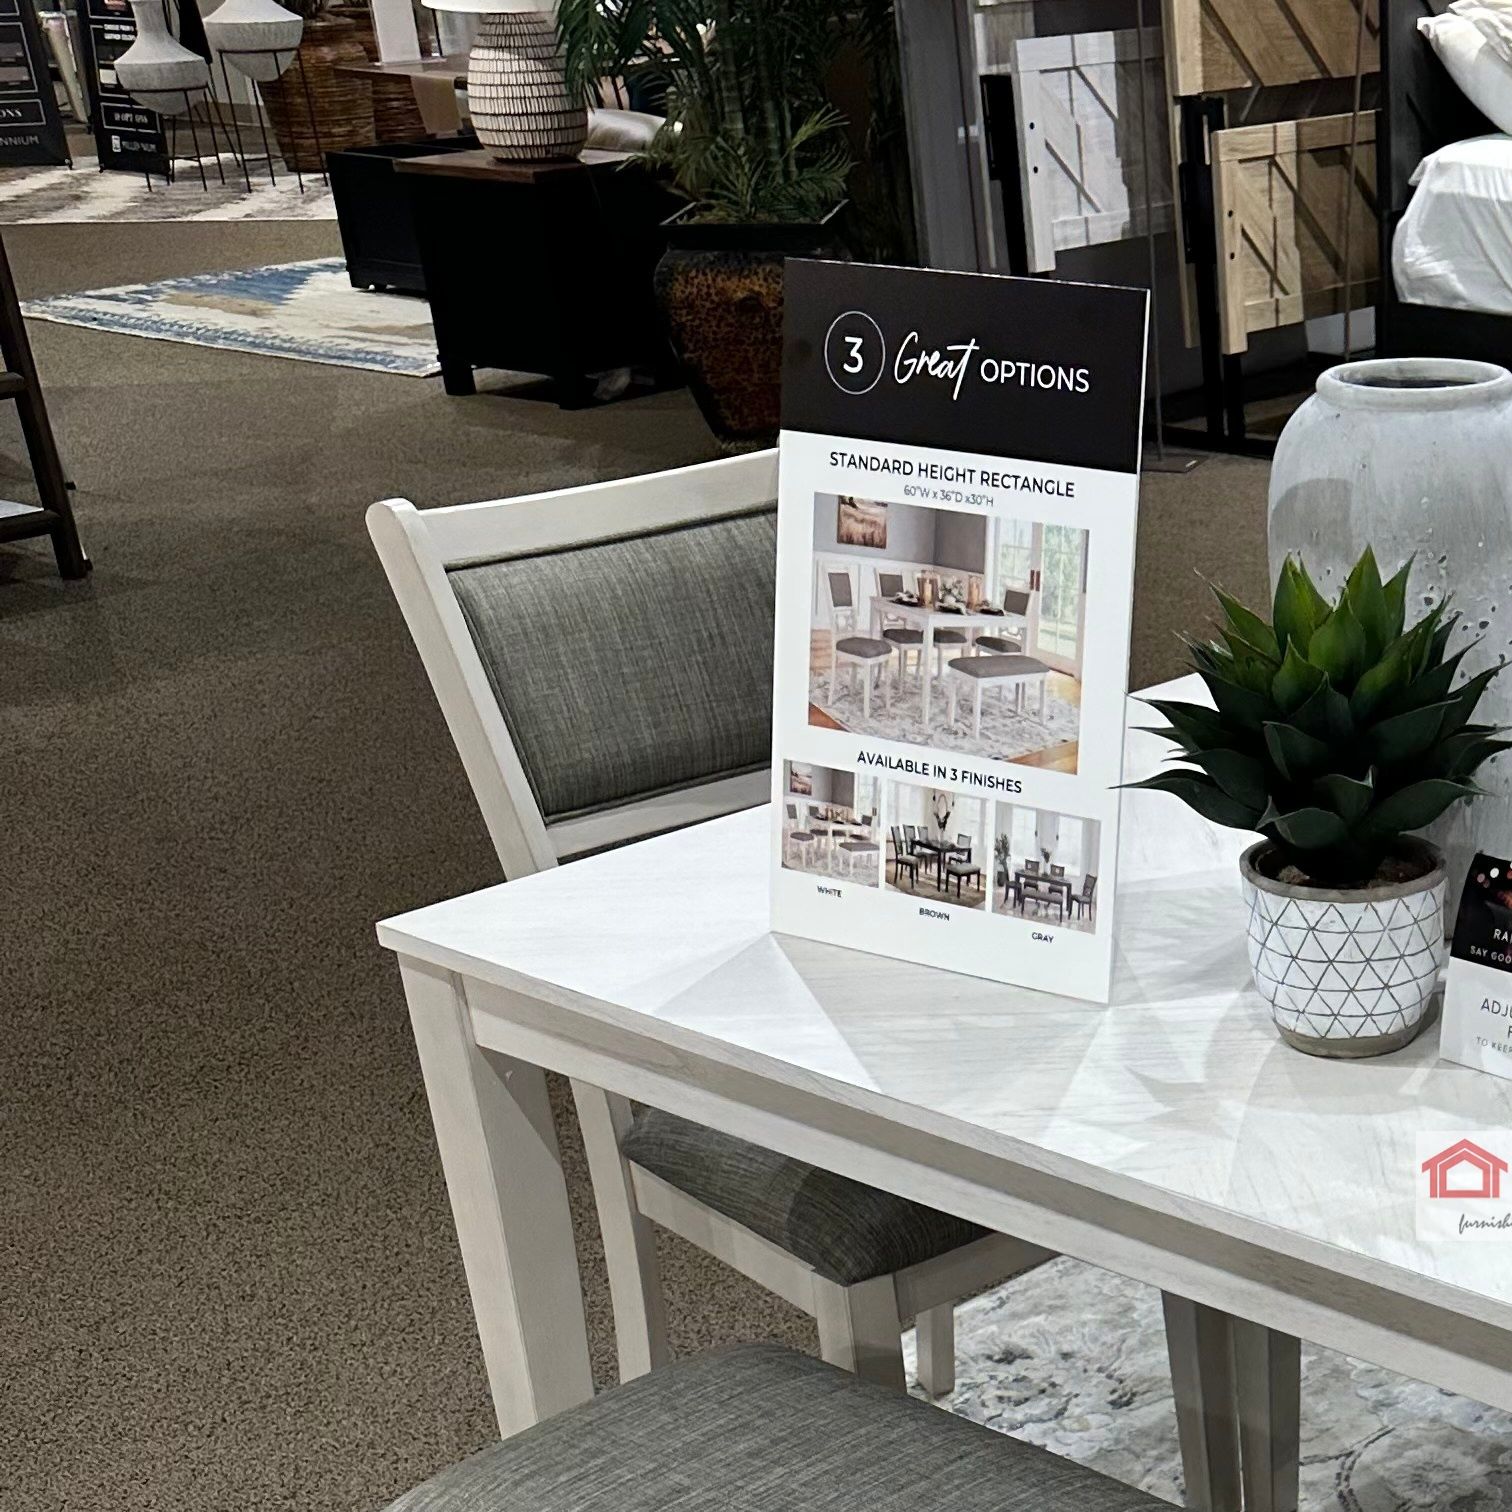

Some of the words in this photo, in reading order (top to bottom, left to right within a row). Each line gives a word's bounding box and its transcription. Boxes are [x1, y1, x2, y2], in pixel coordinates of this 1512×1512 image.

[842, 337, 863, 373] 3
[895, 332, 979, 400] Great
[981, 359, 1090, 393] OPTIONS
[830, 452, 913, 476] STANDARD
[918, 463, 976, 485] HEIGHT
[980, 472, 1075, 498] RECTANGLE
[857, 750, 929, 776] AVAILABLE
[933, 765, 947, 779] IN
[950, 768, 958, 781] 3
[961, 770, 1022, 793] FINISHES
[817, 885, 842, 898] WHITE
[919, 908, 950, 921] BROWN
[1032, 932, 1054, 944] GRAY
[1470, 945, 1488, 959] SAY
[1476, 1036, 1488, 1048] TO
